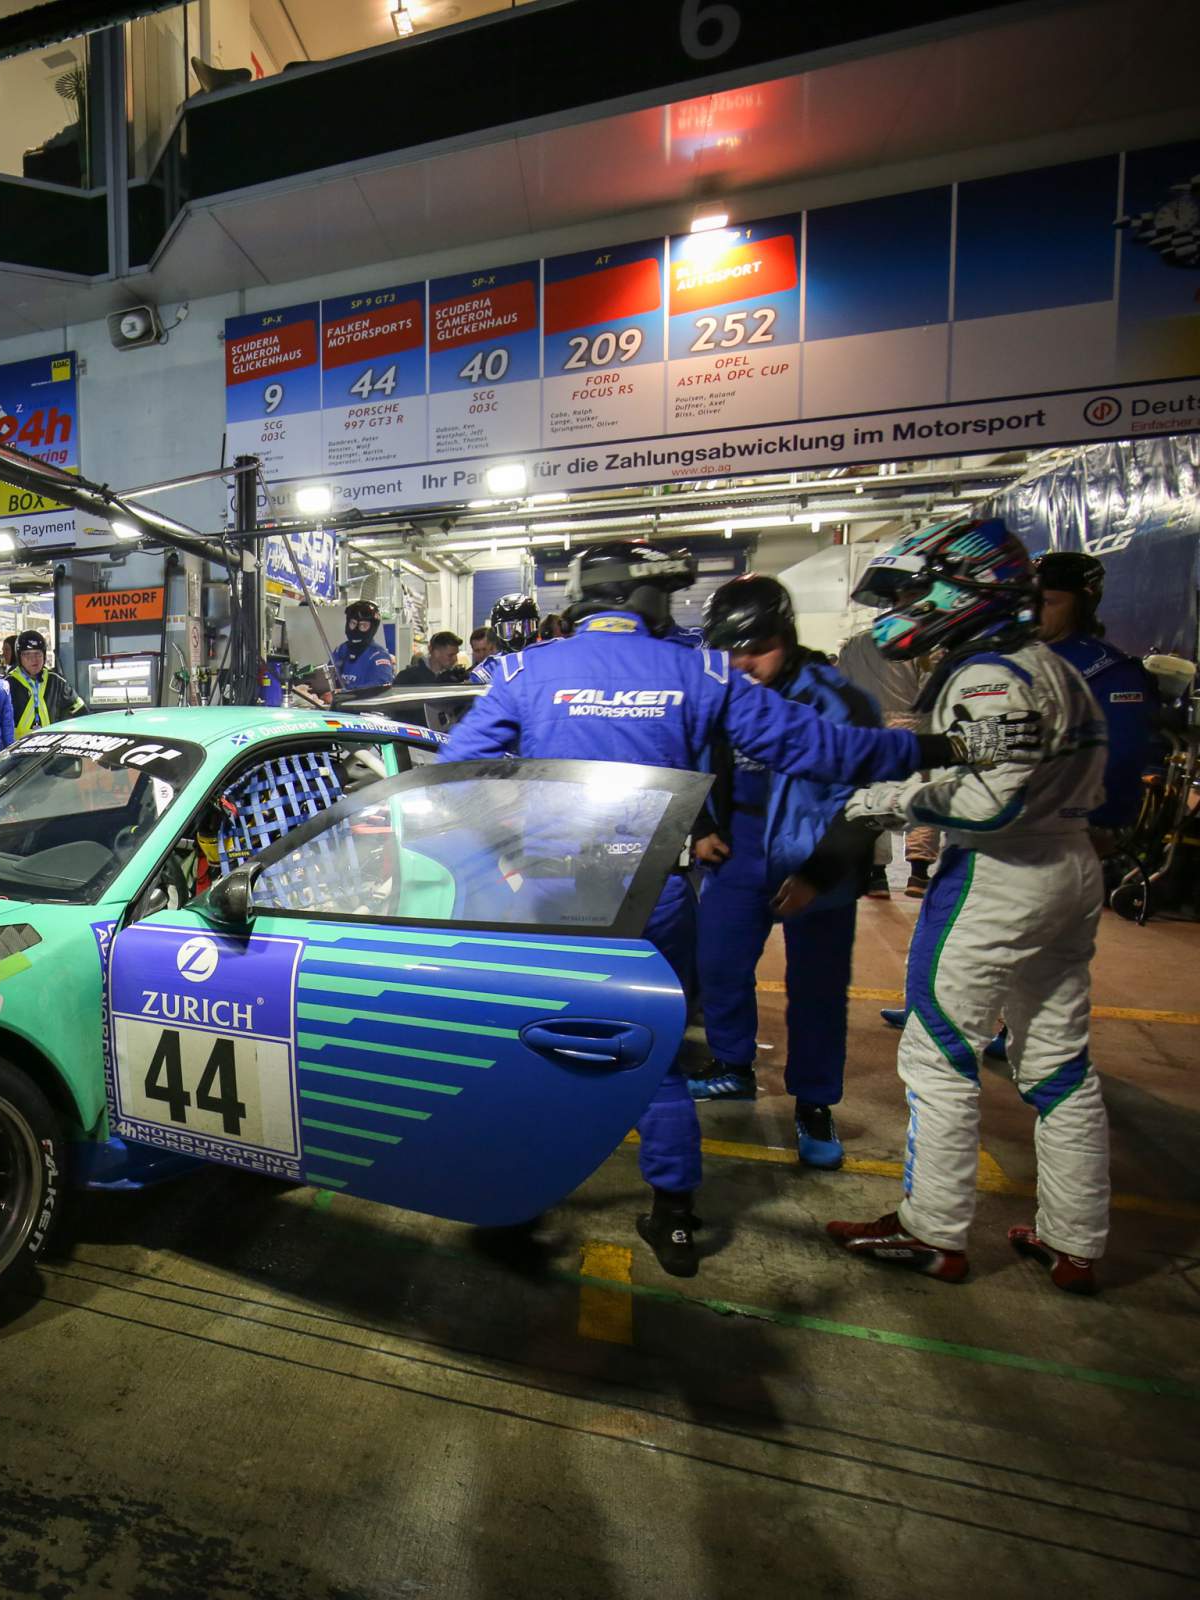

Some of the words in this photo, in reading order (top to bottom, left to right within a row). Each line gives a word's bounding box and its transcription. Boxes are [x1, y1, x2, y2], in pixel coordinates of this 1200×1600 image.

[680, 0, 742, 60] 6
[471, 275, 496, 288] SP-X
[435, 297, 492, 320] SCUDERIA
[327, 319, 370, 338] FALKEN
[436, 308, 493, 331] CAMERON
[436, 312, 518, 341] GLICKENHAUS
[327, 318, 413, 349] MOTORSPORTS
[690, 308, 777, 352] 252
[231, 335, 280, 356] SCUDERIA
[232, 345, 281, 365] CAMERON
[563, 328, 643, 371] 209
[233, 349, 302, 375] GLICKENHAUS
[458, 348, 509, 383] 40
[714, 355, 750, 369] OPEL
[350, 364, 397, 399] 44
[585, 373, 620, 387] FORD
[676, 371, 721, 387] ASTRA
[727, 368, 754, 381] OPC
[760, 363, 789, 377] CUP
[264, 383, 283, 414] 9
[472, 390, 495, 402] SCG
[571, 386, 614, 401] FOCUS
[618, 383, 634, 395] RS
[348, 403, 400, 419] PORSCHE
[469, 401, 499, 414] 003C
[263, 420, 283, 431] SCG
[344, 419, 366, 431] 997
[368, 416, 392, 428] GT3
[396, 414, 404, 424] R
[260, 431, 287, 442] 003C
[421, 473, 448, 489] Ihr
[567, 457, 599, 474] die
[604, 432, 846, 471] Zahlungsabwicklung
[853, 427, 884, 446] im
[892, 409, 1046, 442] Motorsport
[671, 463, 732, 477] www.dp.ag
[8, 493, 45, 513] BOX
[23, 519, 76, 538] Payment
[86, 591, 157, 609] MUNDORF
[103, 607, 137, 621] TANK
[553, 689, 684, 705] FALKEN
[568, 705, 667, 719] MOTORSPORTS
[141, 990, 254, 1030] ZURICH
[144, 1028, 247, 1137] 44
[137, 1124, 300, 1171] NÜRBURGRING
[137, 1133, 301, 1180] NORDSCHLEIFE
[28, 1138, 60, 1253] FALKEN
